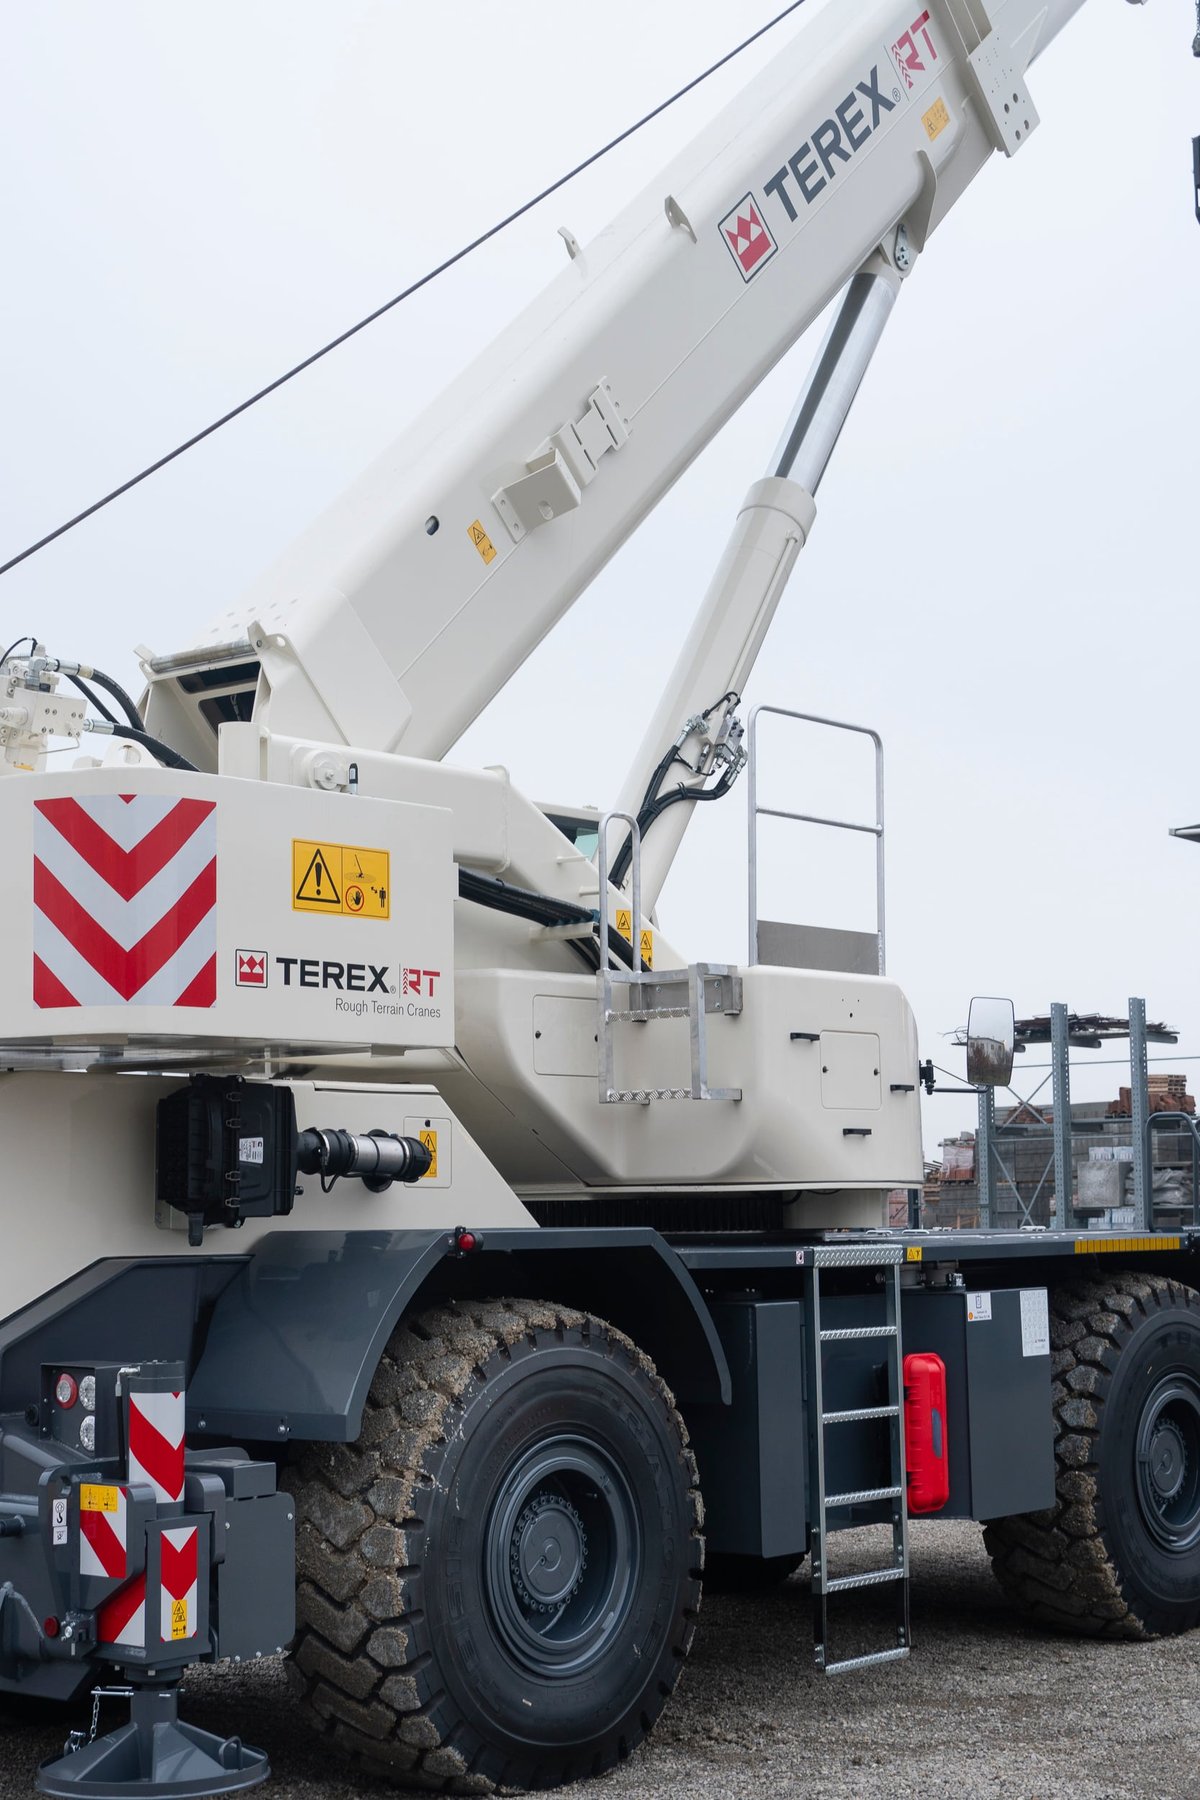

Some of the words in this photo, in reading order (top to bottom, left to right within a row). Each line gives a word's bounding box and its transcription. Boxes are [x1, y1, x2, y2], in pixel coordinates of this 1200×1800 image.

[891, 9, 938, 89] RT
[403, 967, 441, 997] RT
[335, 997, 368, 1016] Rough
[371, 1000, 404, 1015] Terrain
[407, 1003, 441, 1018] Cranes
